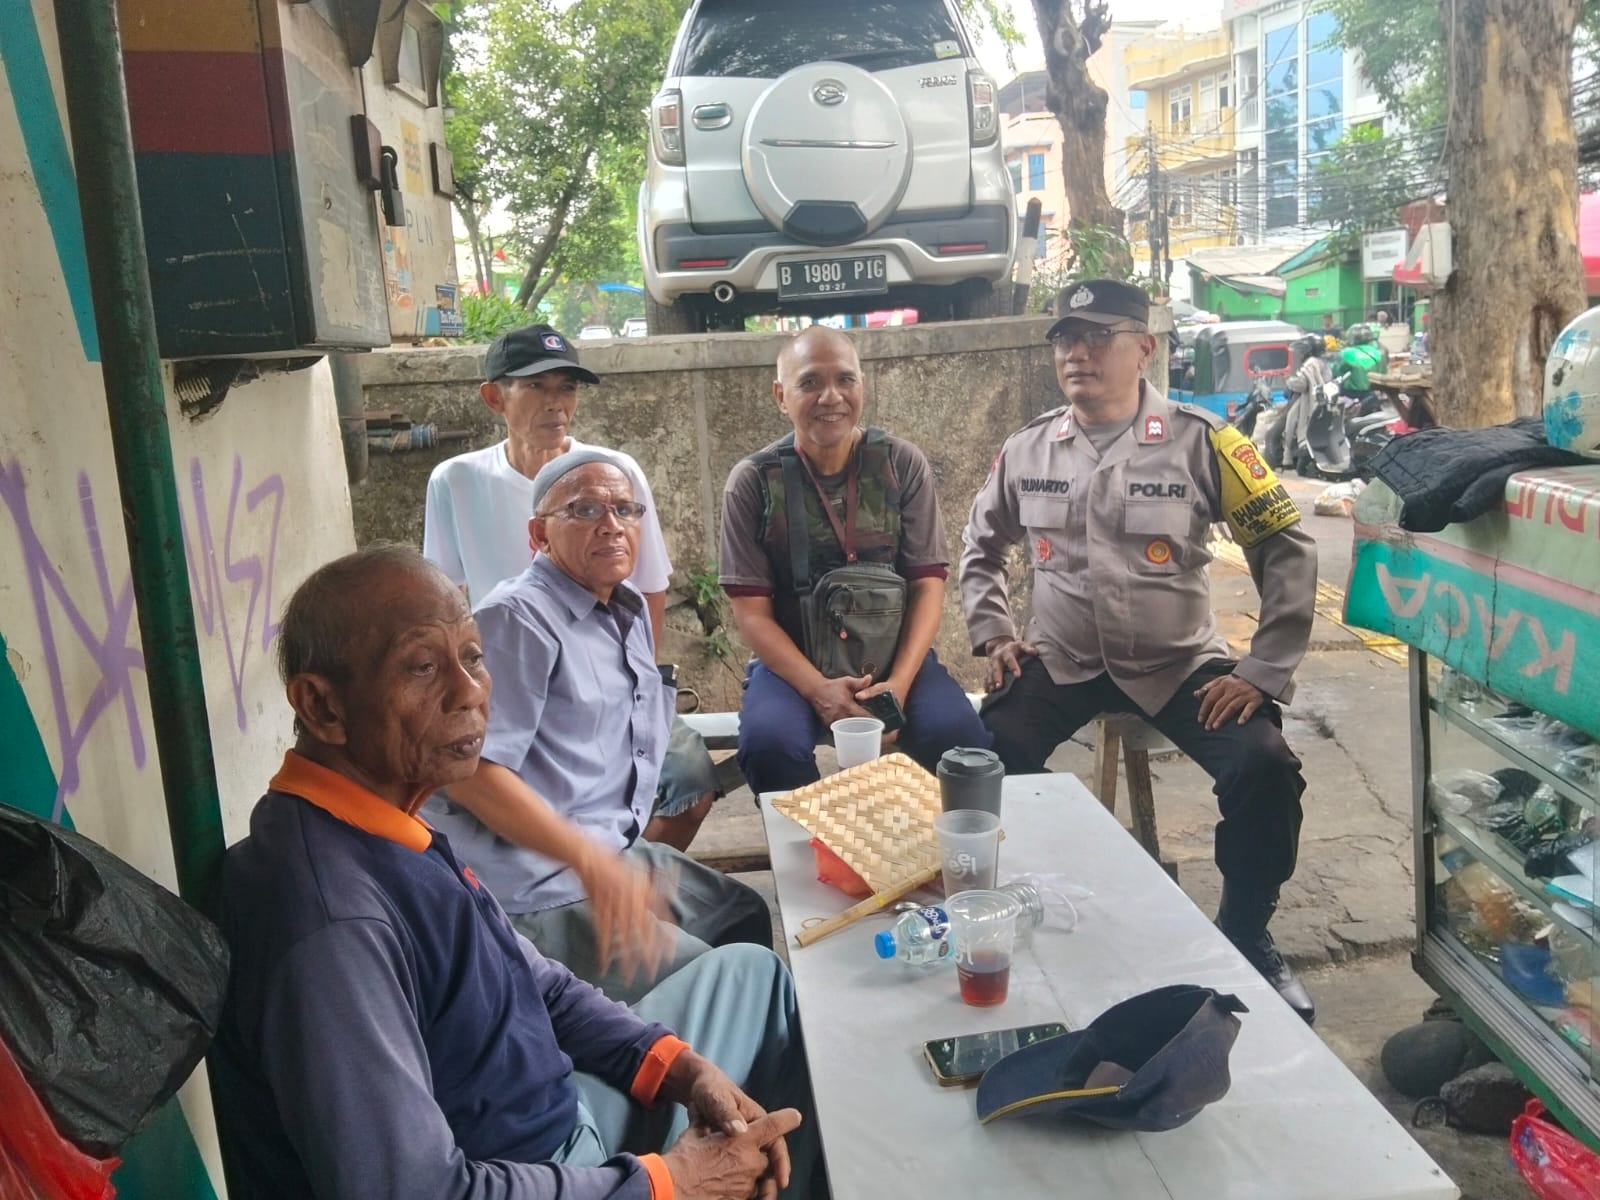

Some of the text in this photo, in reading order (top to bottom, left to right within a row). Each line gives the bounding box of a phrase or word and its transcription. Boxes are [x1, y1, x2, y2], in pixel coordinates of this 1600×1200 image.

[405, 208, 434, 246] PLN
[781, 259, 883, 286] B 1980 PIG
[1129, 482, 1187, 499] POLRI
[1375, 562, 1576, 695] KACA
